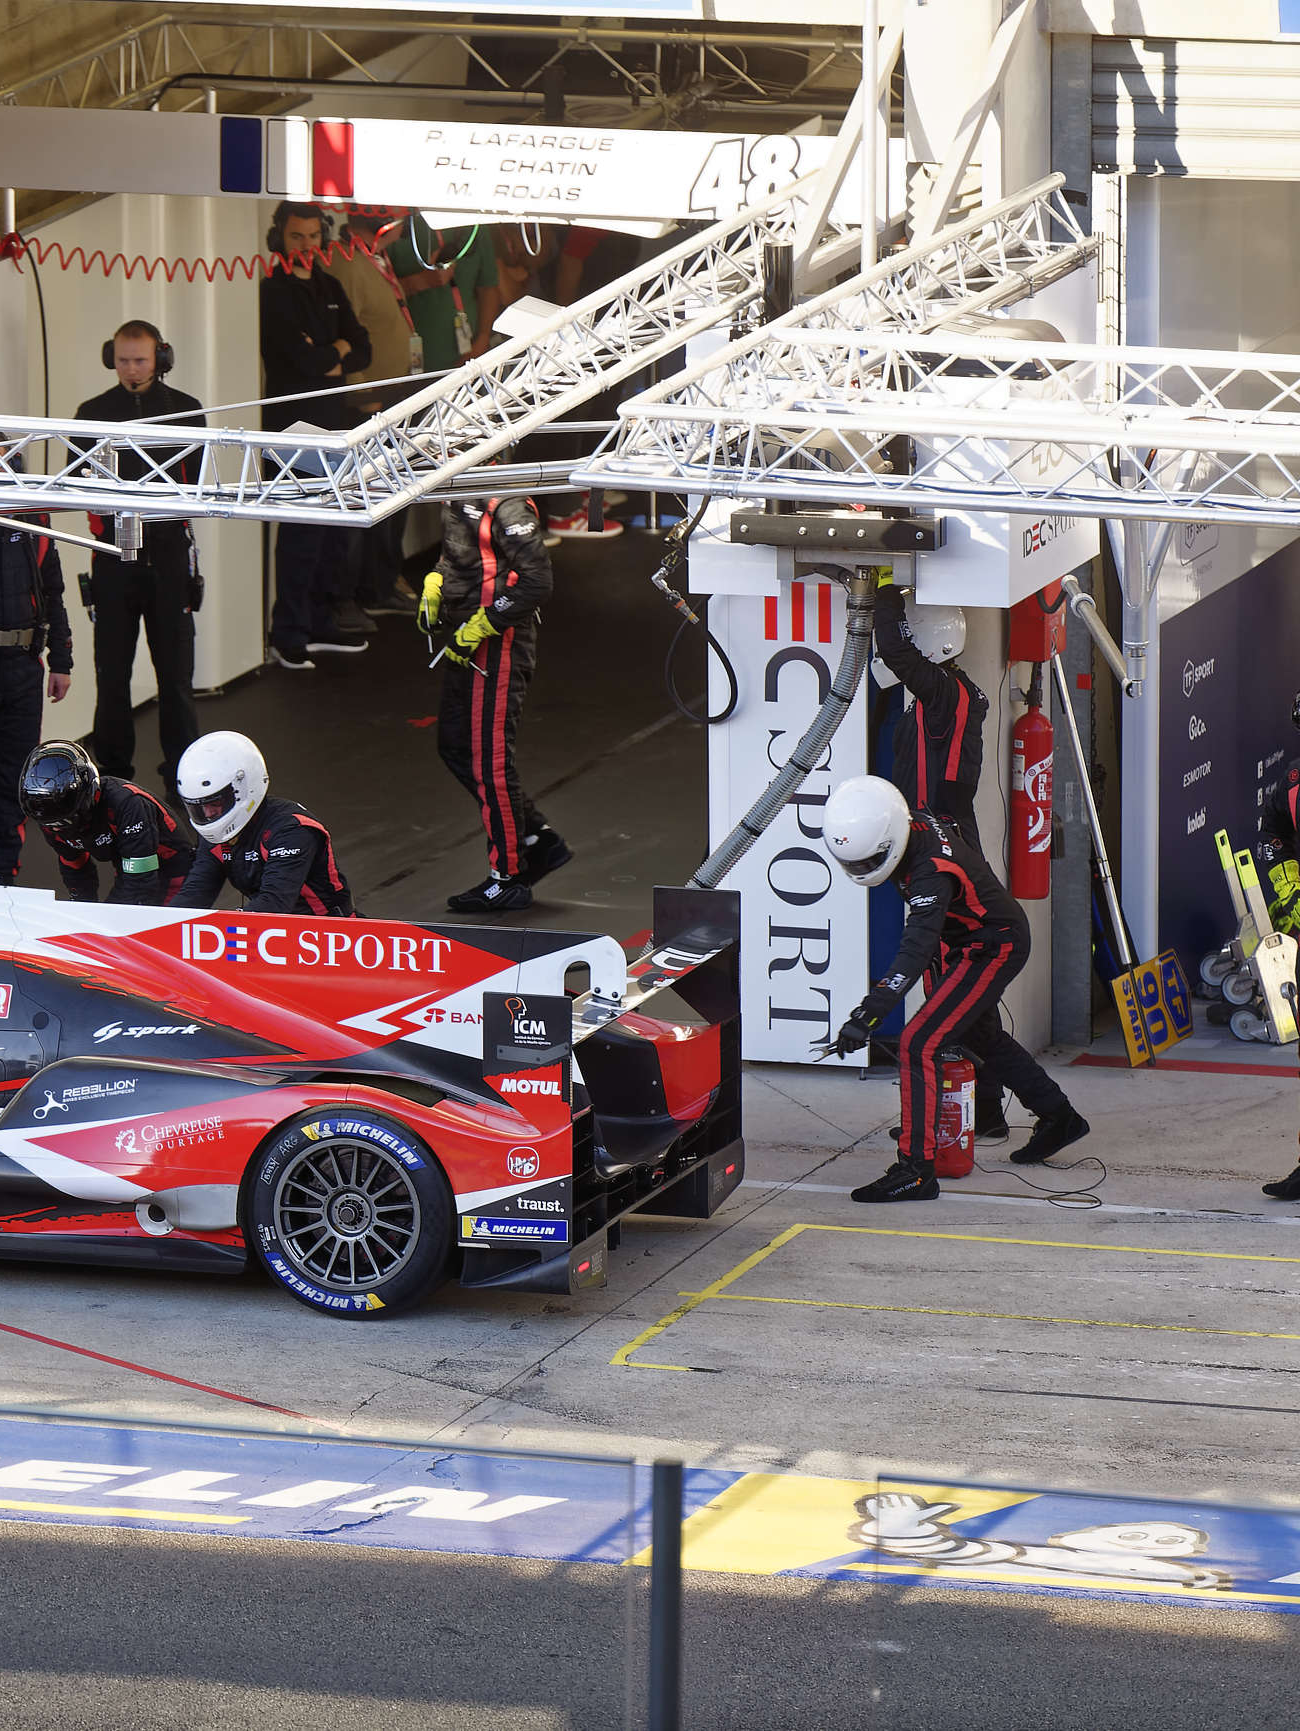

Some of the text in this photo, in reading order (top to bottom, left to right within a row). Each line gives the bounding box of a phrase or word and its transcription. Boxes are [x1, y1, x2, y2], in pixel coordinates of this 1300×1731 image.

[469, 131, 615, 152] LAFARGUE
[499, 159, 598, 177] CHATIN
[688, 134, 801, 219] 48
[492, 184, 583, 202] ROJAS
[1022, 519, 1047, 559] IDEC
[181, 923, 453, 974] IDEC SPORT
[1121, 977, 1147, 1056] START
[121, 1024, 203, 1038] spark
[514, 1019, 547, 1036] ICM
[62, 1079, 136, 1099] REBELLION
[500, 1078, 562, 1096] MOTUL
[140, 1115, 223, 1144] CHEVREUSE
[144, 1129, 226, 1153] COURTAGE
[335, 1120, 421, 1166] MICHELIN
[516, 1196, 565, 1214] traust.
[491, 1224, 556, 1237] MICHELIN
[271, 1258, 350, 1310] MICHELIN
